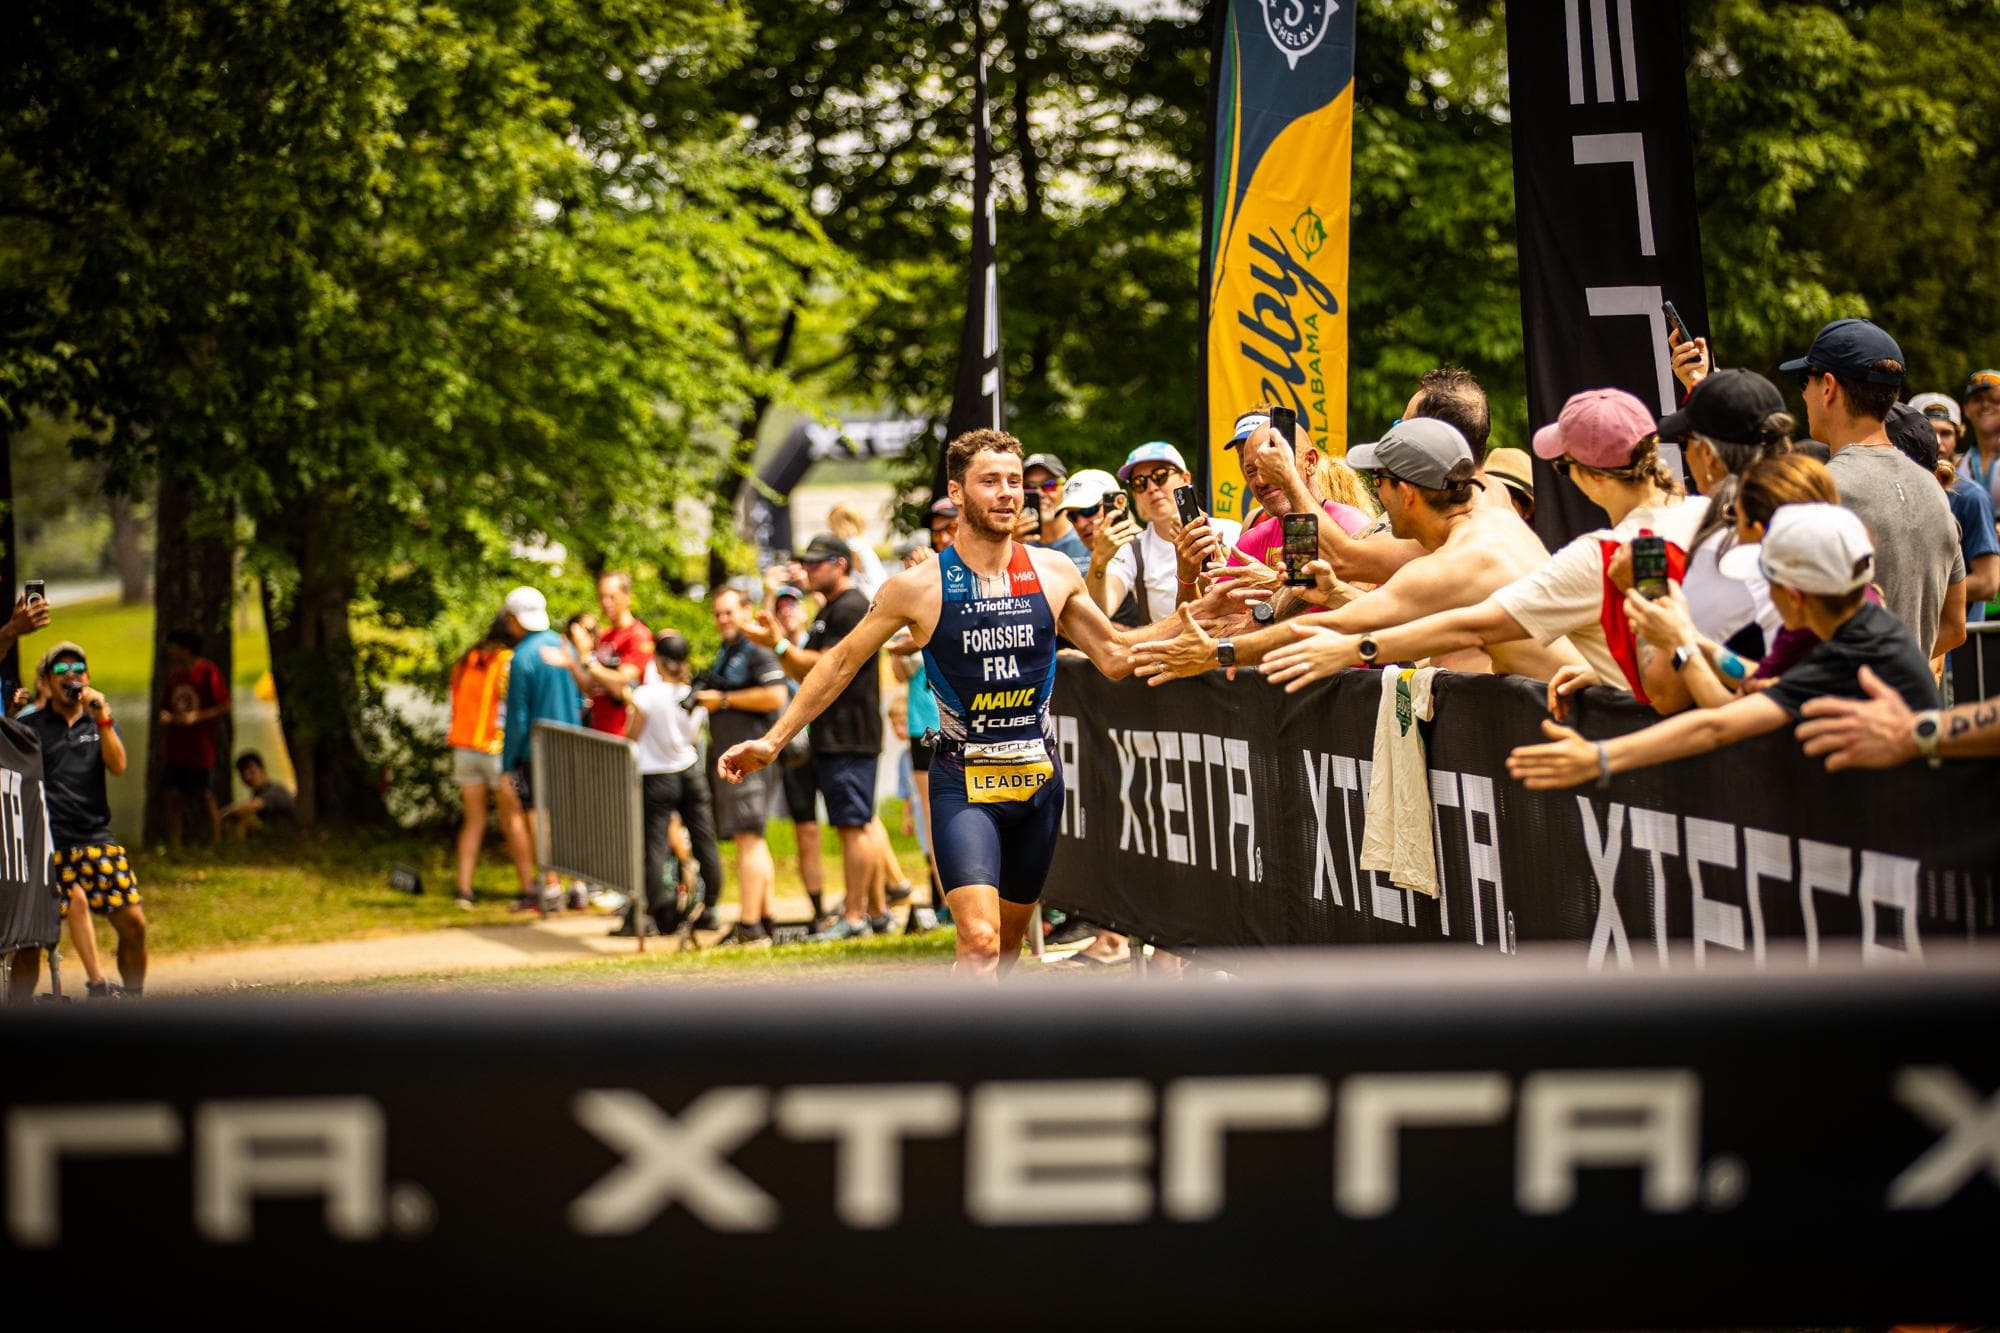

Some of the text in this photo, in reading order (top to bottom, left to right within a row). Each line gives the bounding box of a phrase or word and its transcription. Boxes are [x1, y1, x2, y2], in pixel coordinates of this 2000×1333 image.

[1272, 18, 1315, 46] SHELBY
[1303, 313, 1329, 453] ALABAMA
[962, 624, 1035, 654] FORISSIER
[983, 655, 1020, 681] FRA
[970, 688, 1035, 711] MAVIC
[987, 714, 1036, 728] CUBE
[974, 773, 1047, 789] LEADER
[1107, 729, 1256, 882] XTERRA
[568, 1068, 1700, 1235] XTERRA
